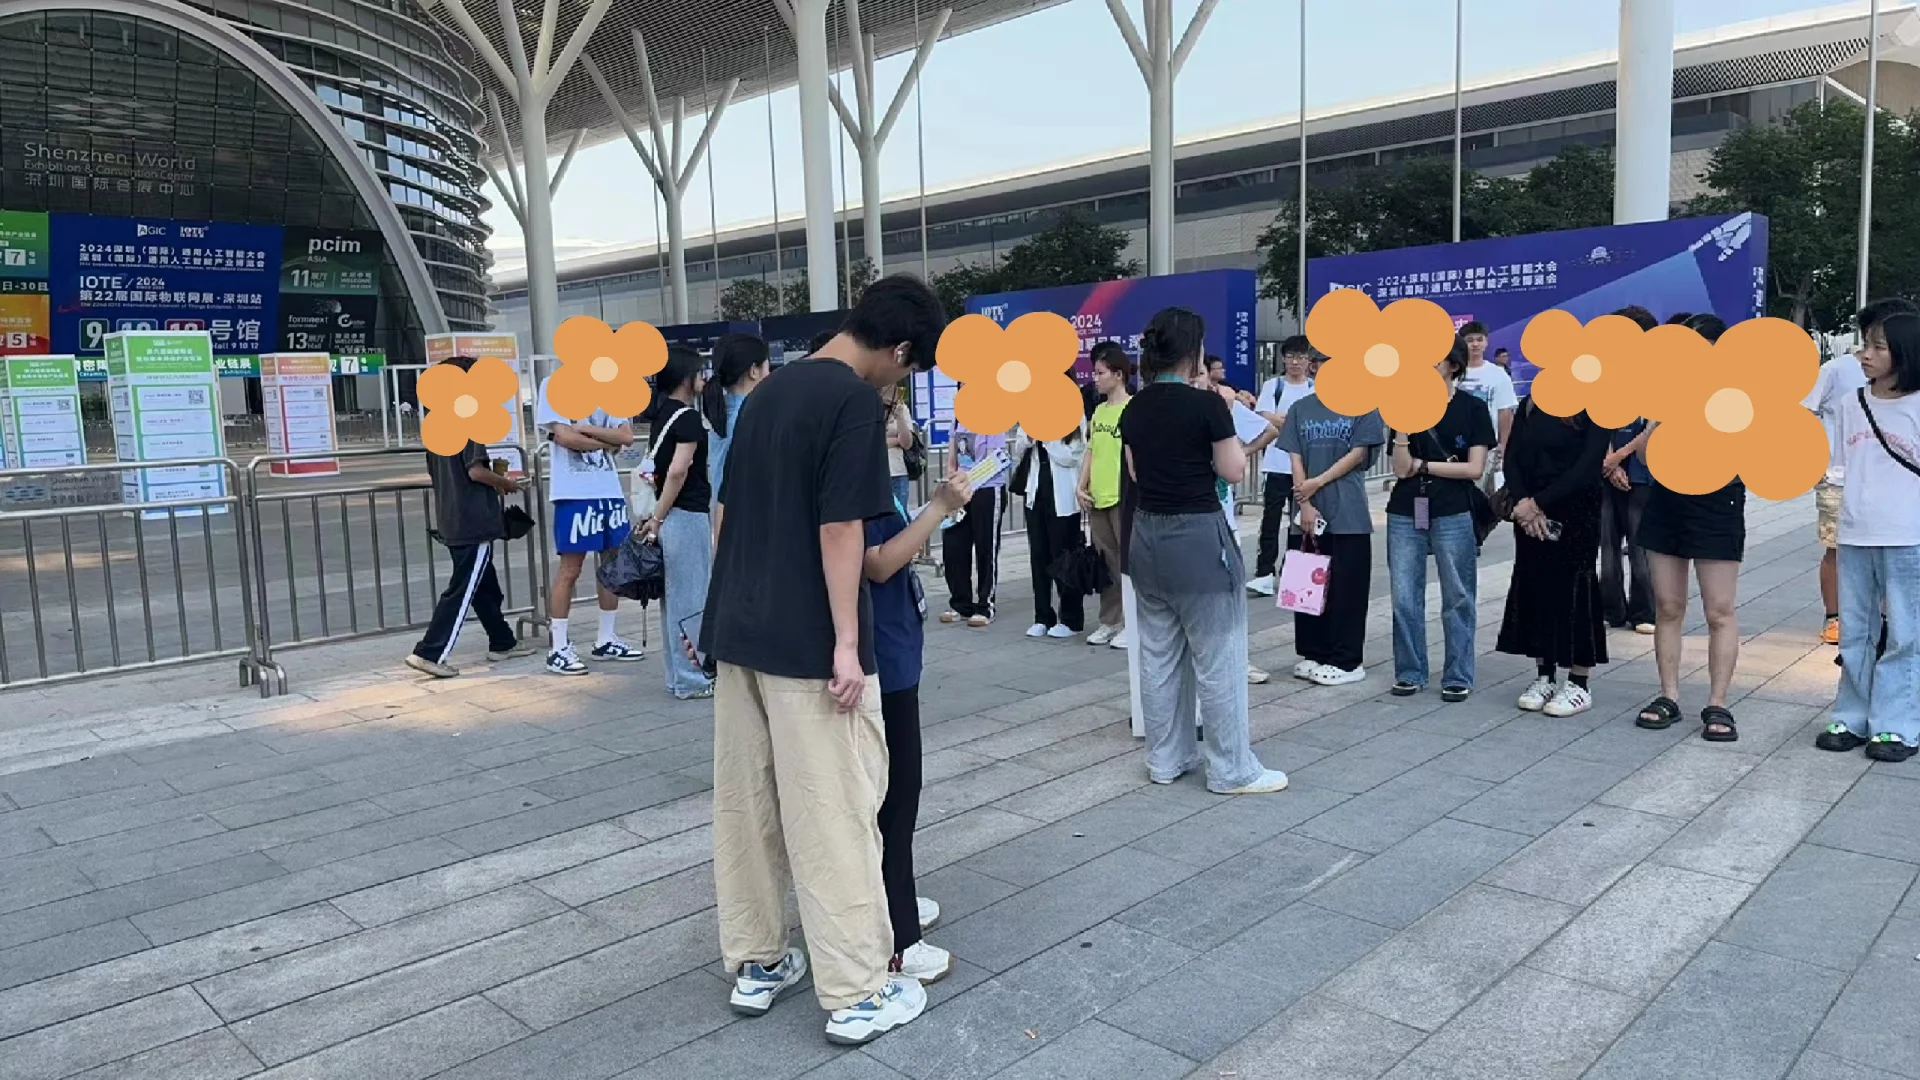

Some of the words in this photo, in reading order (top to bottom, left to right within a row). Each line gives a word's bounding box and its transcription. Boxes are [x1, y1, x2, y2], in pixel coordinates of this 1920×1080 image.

[24, 142, 127, 165] Shenzhen
[135, 151, 196, 170] World
[24, 159, 81, 173] Exhibition
[85, 164, 93, 173] &
[96, 165, 158, 178] Convention
[159, 169, 194, 181] Center
[25, 172, 195, 196] 深圳国际会展中心
[137, 224, 166, 237] AGIC
[308, 236, 361, 254] pcim
[10, 251, 20, 264] 7
[80, 275, 122, 289] IOTE
[136, 277, 165, 287] 2024
[291, 269, 310, 287] 11
[310, 280, 325, 288] Hall
[79, 289, 262, 305] 第22届国际物联网展·深圳站
[288, 314, 329, 324] formnext
[1069, 313, 1102, 329] 2024
[86, 322, 102, 348] 9
[211, 319, 261, 341] 号馆
[11, 334, 22, 346] 5
[286, 332, 308, 349] 13
[344, 358, 353, 372] 7
